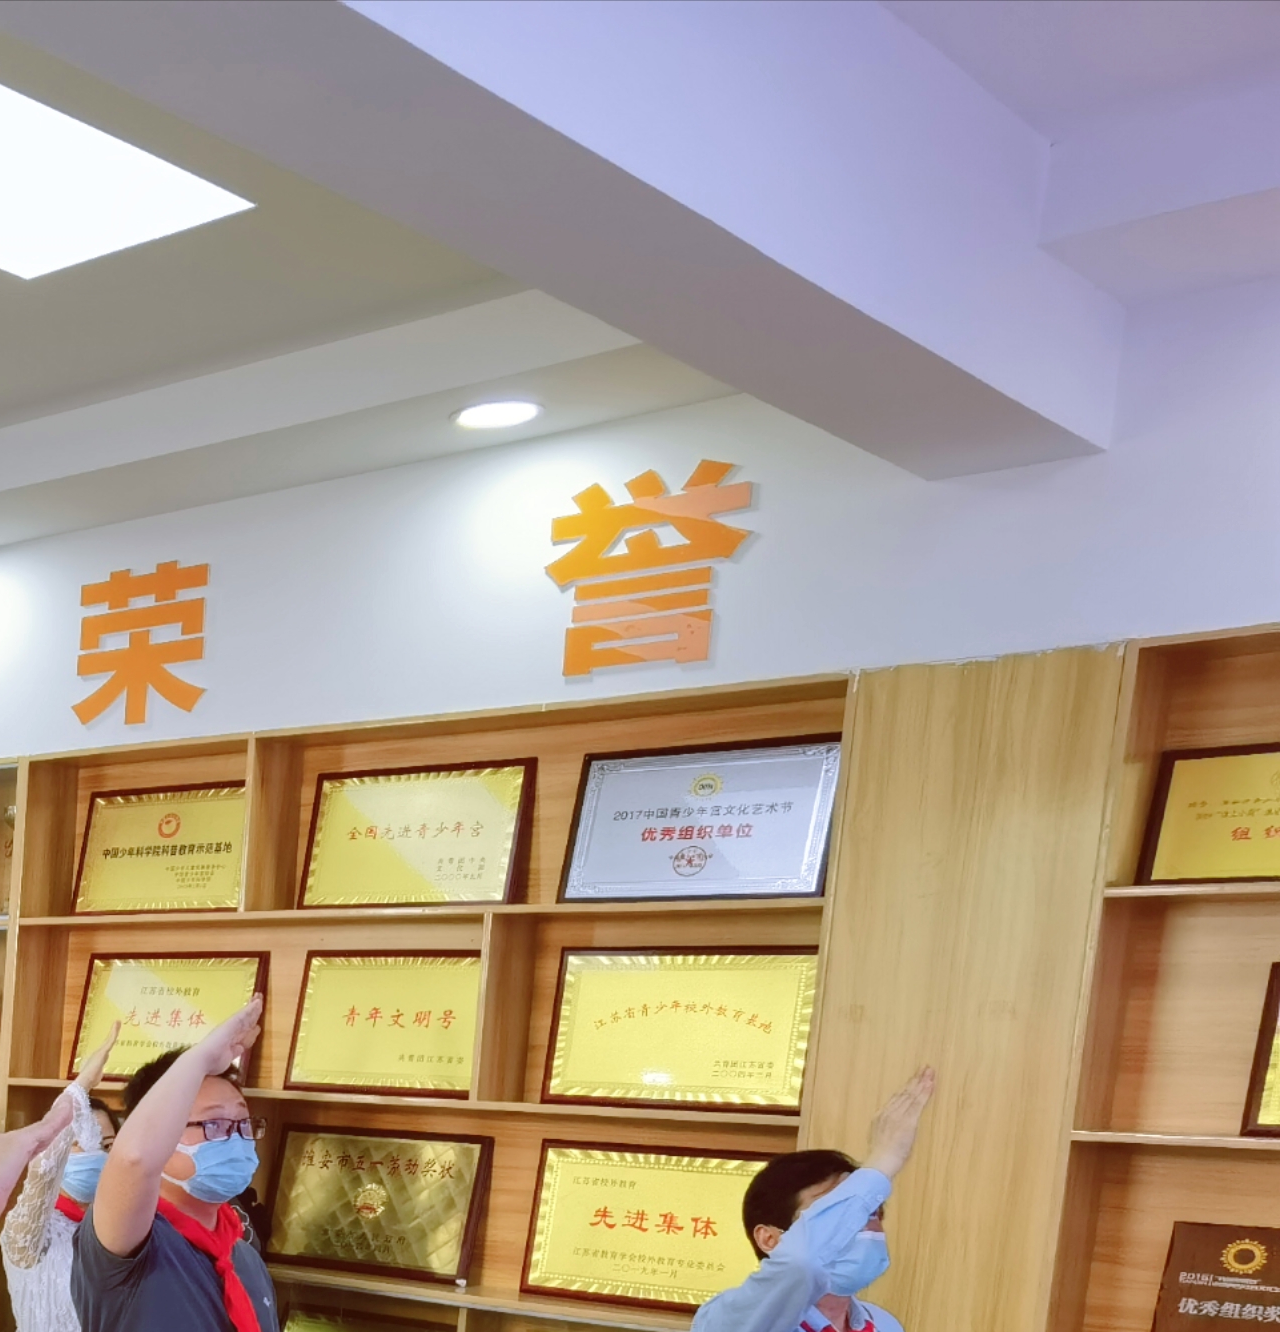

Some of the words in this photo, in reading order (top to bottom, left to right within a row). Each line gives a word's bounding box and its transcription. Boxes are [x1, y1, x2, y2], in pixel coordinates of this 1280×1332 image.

[71, 560, 209, 726] 荣
[545, 458, 753, 677] 誉
[613, 801, 794, 821] 2017中国青少年宫文化艺术节
[347, 820, 484, 841] 全国先进青少年宫
[641, 823, 754, 842] 优秀组织单位
[102, 841, 233, 860] 中国少年科学院科普教育示范基地
[123, 1006, 206, 1028] 先进集体
[342, 1005, 457, 1030] 青年文明号
[593, 1000, 773, 1035] 江苏省青少年校外教育基地
[302, 1150, 455, 1180] 淮安市五一劳动奖状
[572, 1175, 637, 1190] 江苏省校外教育
[589, 1206, 719, 1239] 先进集体
[573, 1247, 726, 1272] 江苏省教育学会校外教育专业委员会
[1178, 1297, 1280, 1323] 优秀组织奖
